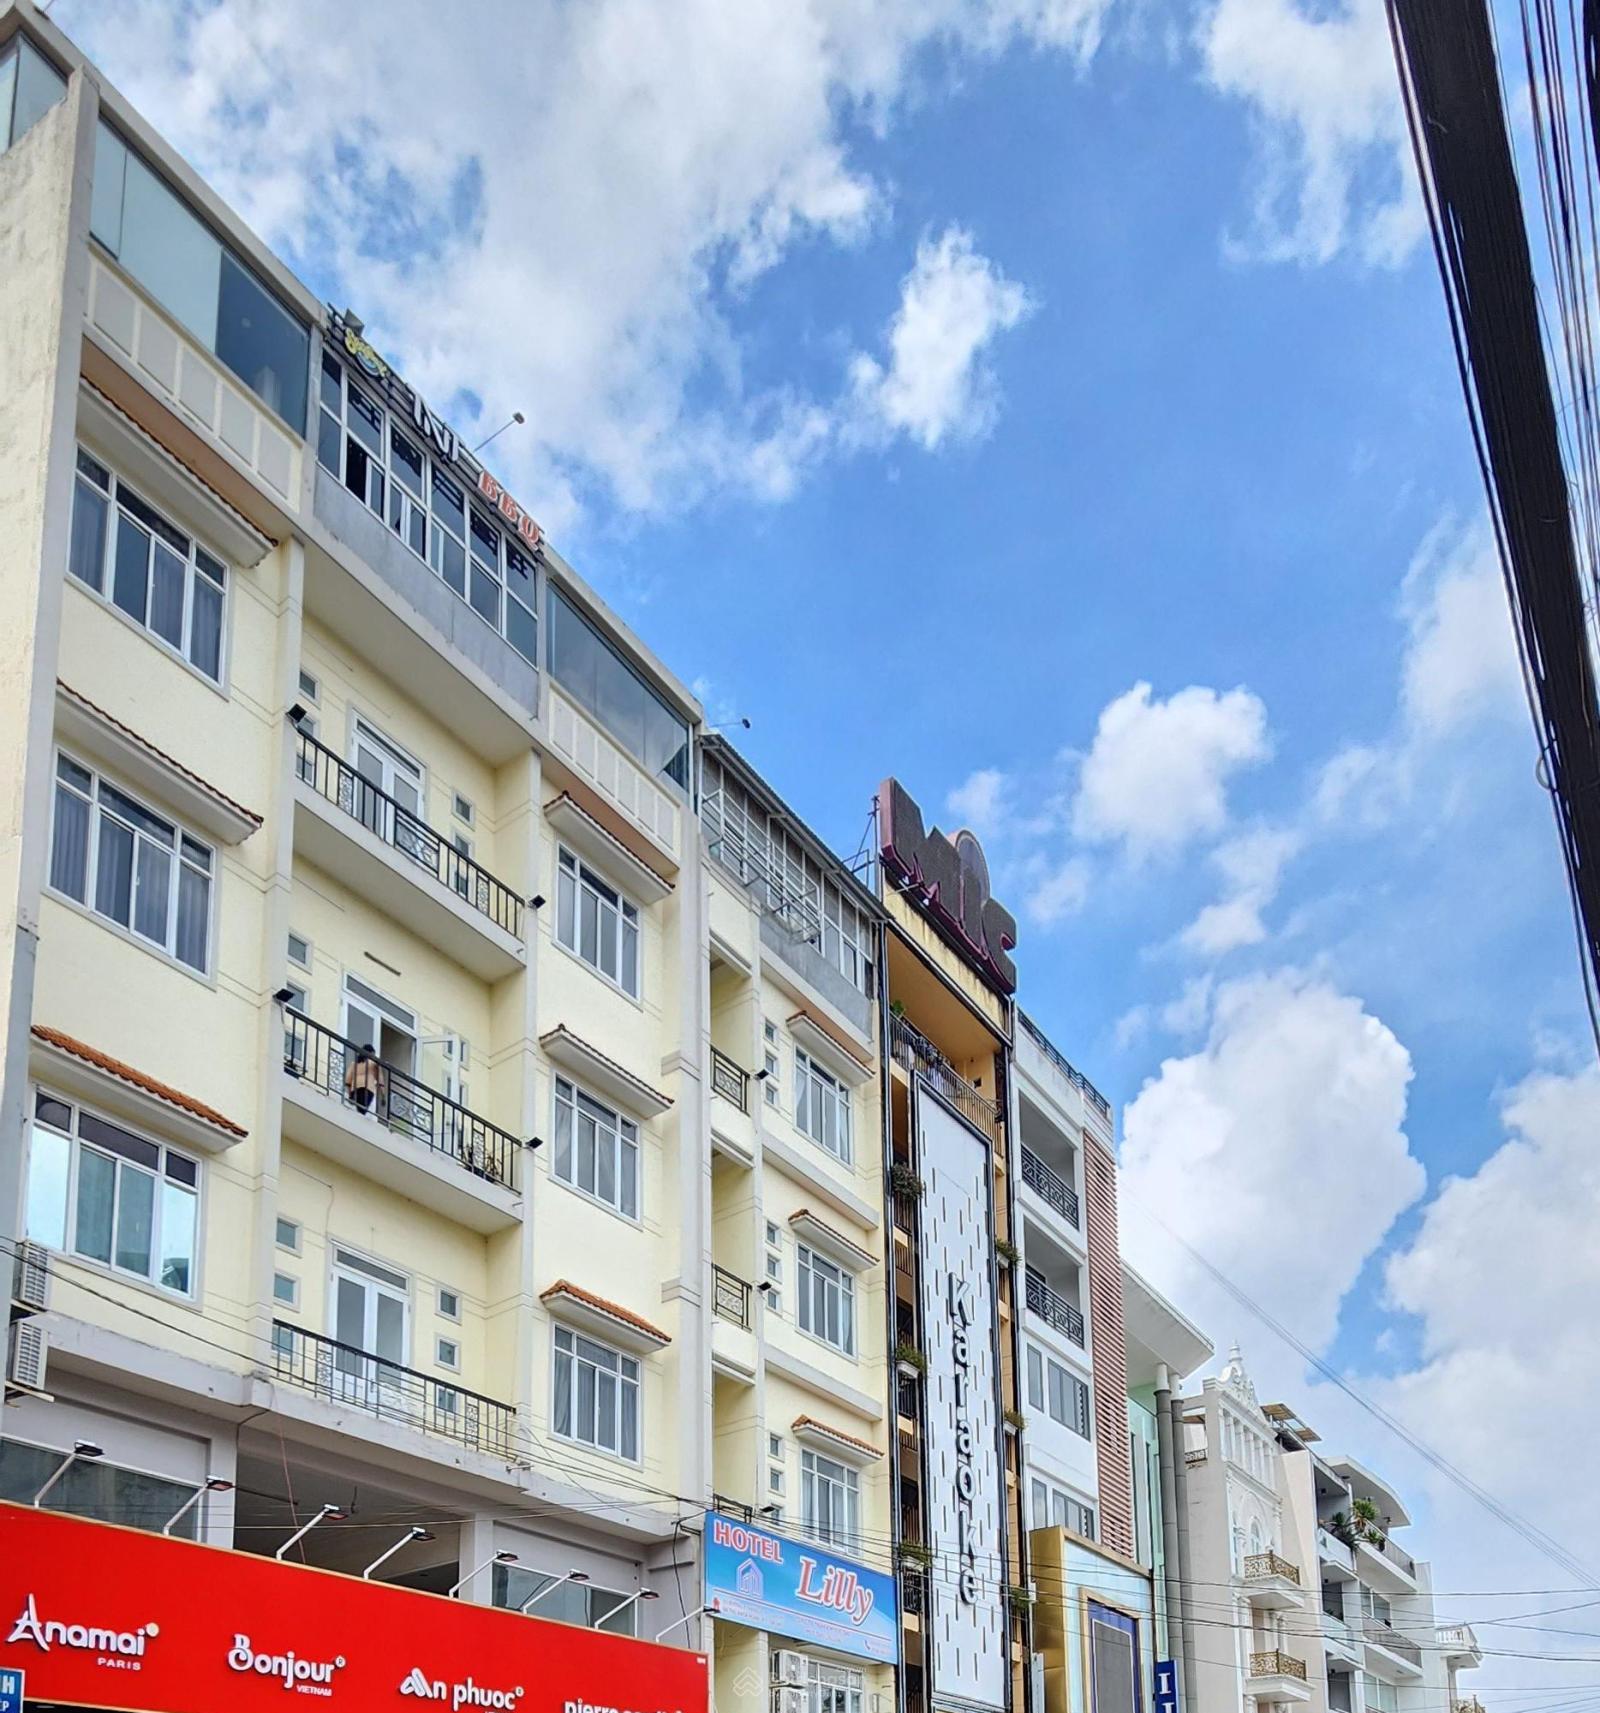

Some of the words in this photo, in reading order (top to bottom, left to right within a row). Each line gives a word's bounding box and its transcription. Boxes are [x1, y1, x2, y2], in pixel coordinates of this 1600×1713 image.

[949, 1270, 979, 1606] Karaoke
[713, 1519, 784, 1564] HOTEL
[796, 1555, 874, 1626] Lilly
[7, 1592, 145, 1656] Anamai
[97, 1657, 142, 1671] PARIS
[228, 1633, 335, 1689] Bonjour
[296, 1684, 332, 1697] VIETNAM
[453, 1676, 516, 1712] phuoc
